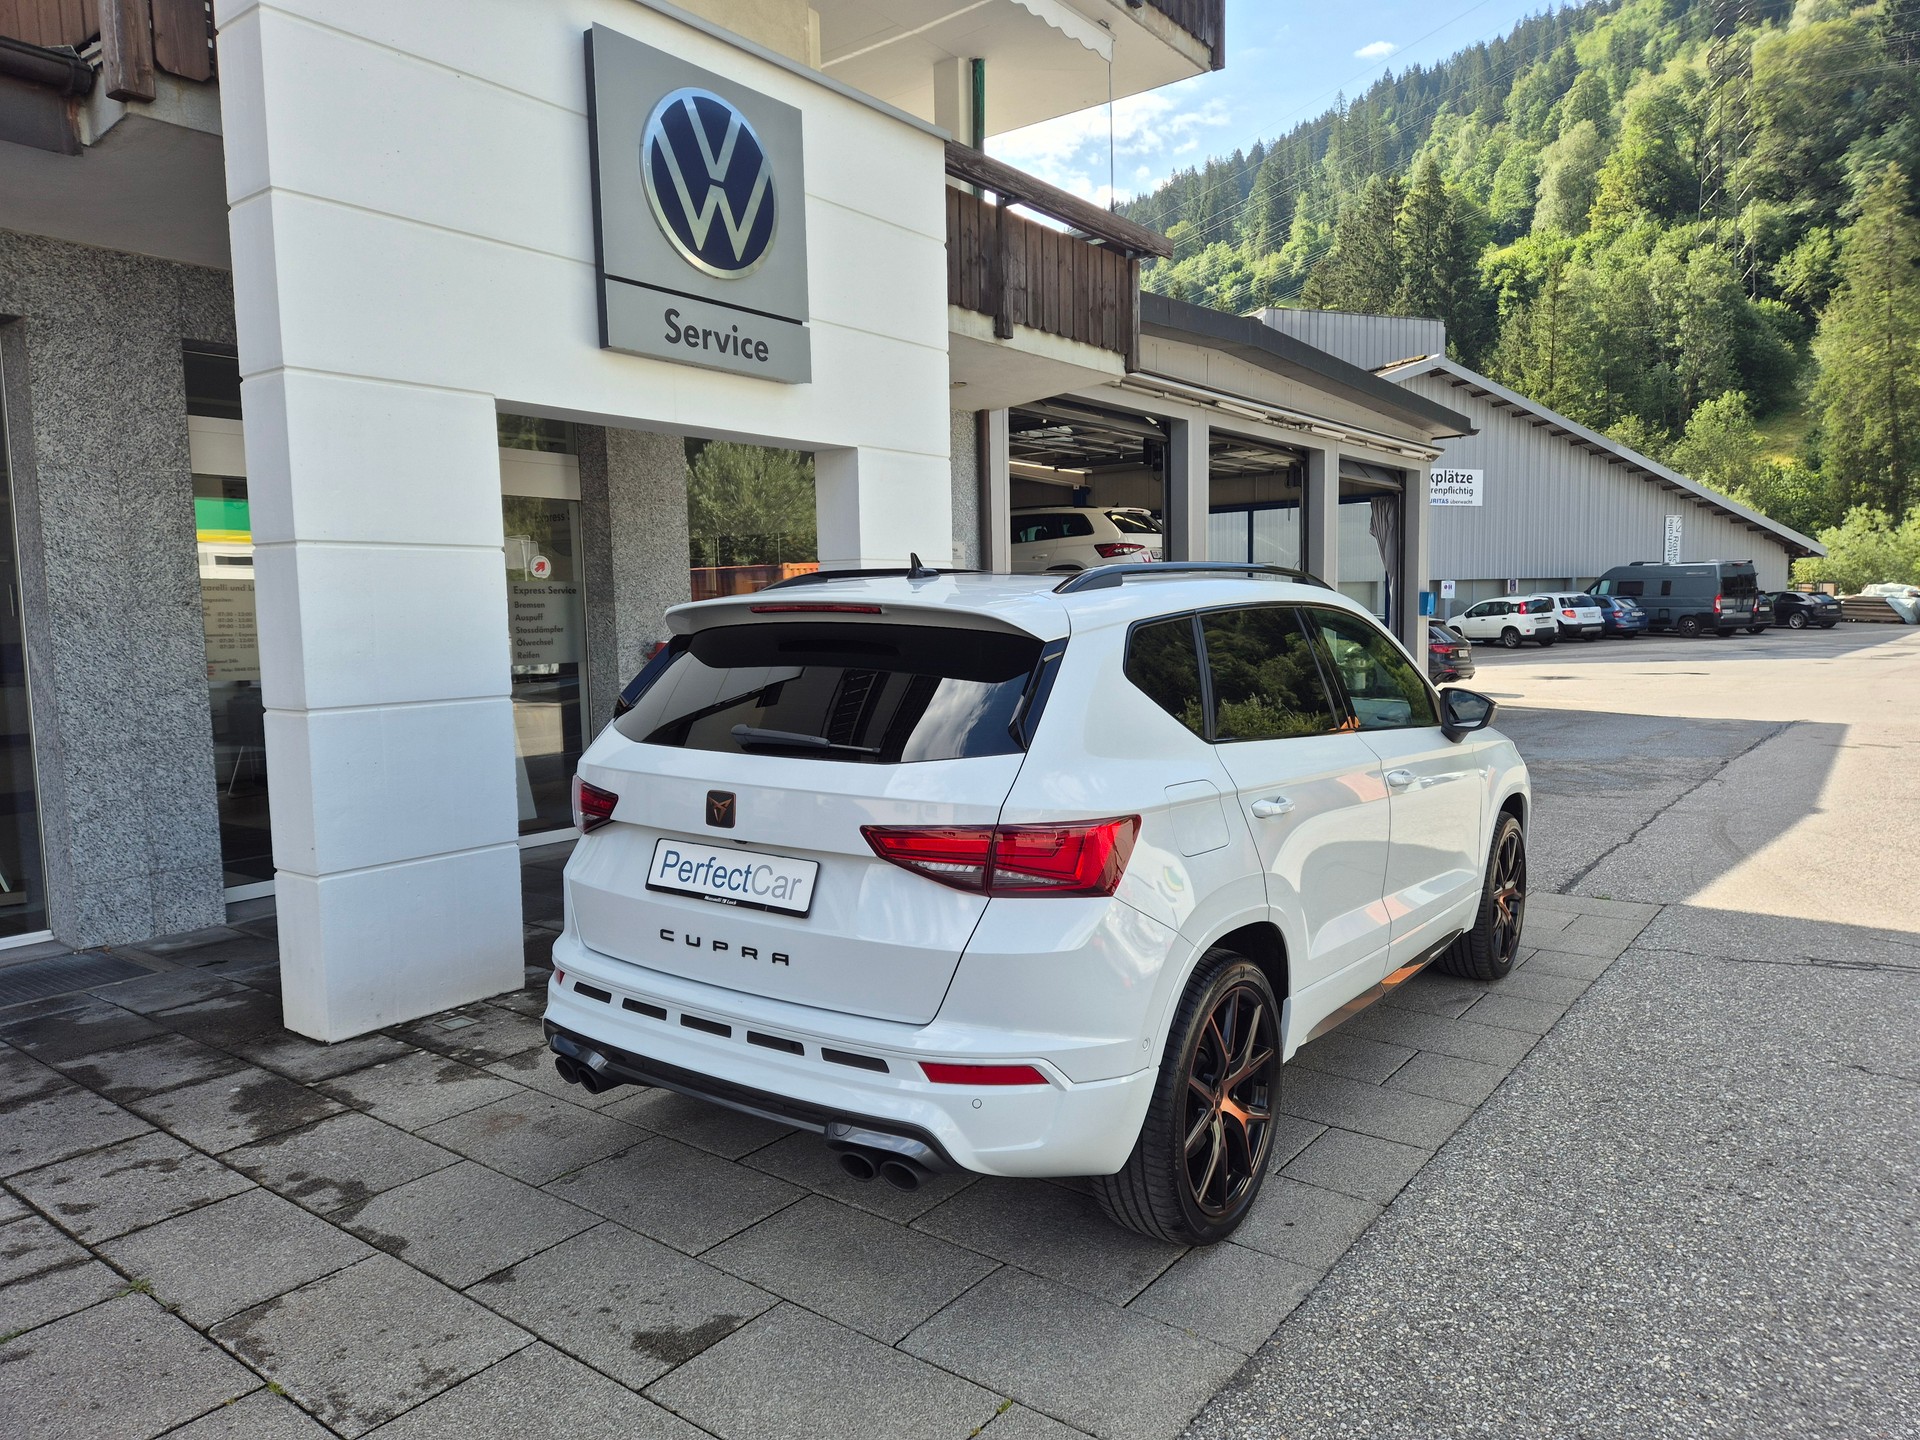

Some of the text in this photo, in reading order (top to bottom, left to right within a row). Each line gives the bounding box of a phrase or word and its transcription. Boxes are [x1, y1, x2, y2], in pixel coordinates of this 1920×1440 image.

[664, 308, 770, 363] Service
[1430, 485, 1474, 497] renpflichtig
[534, 511, 565, 522] Express
[513, 585, 577, 596] Express Service
[514, 601, 546, 609] Bremsen
[515, 613, 543, 622] Auspuff
[516, 625, 564, 634] Stossdämpfer
[516, 637, 554, 647] Ölwechsel
[517, 650, 540, 660] Reifen
[659, 849, 803, 901] PerfectCar
[659, 928, 790, 967] CUPRA
